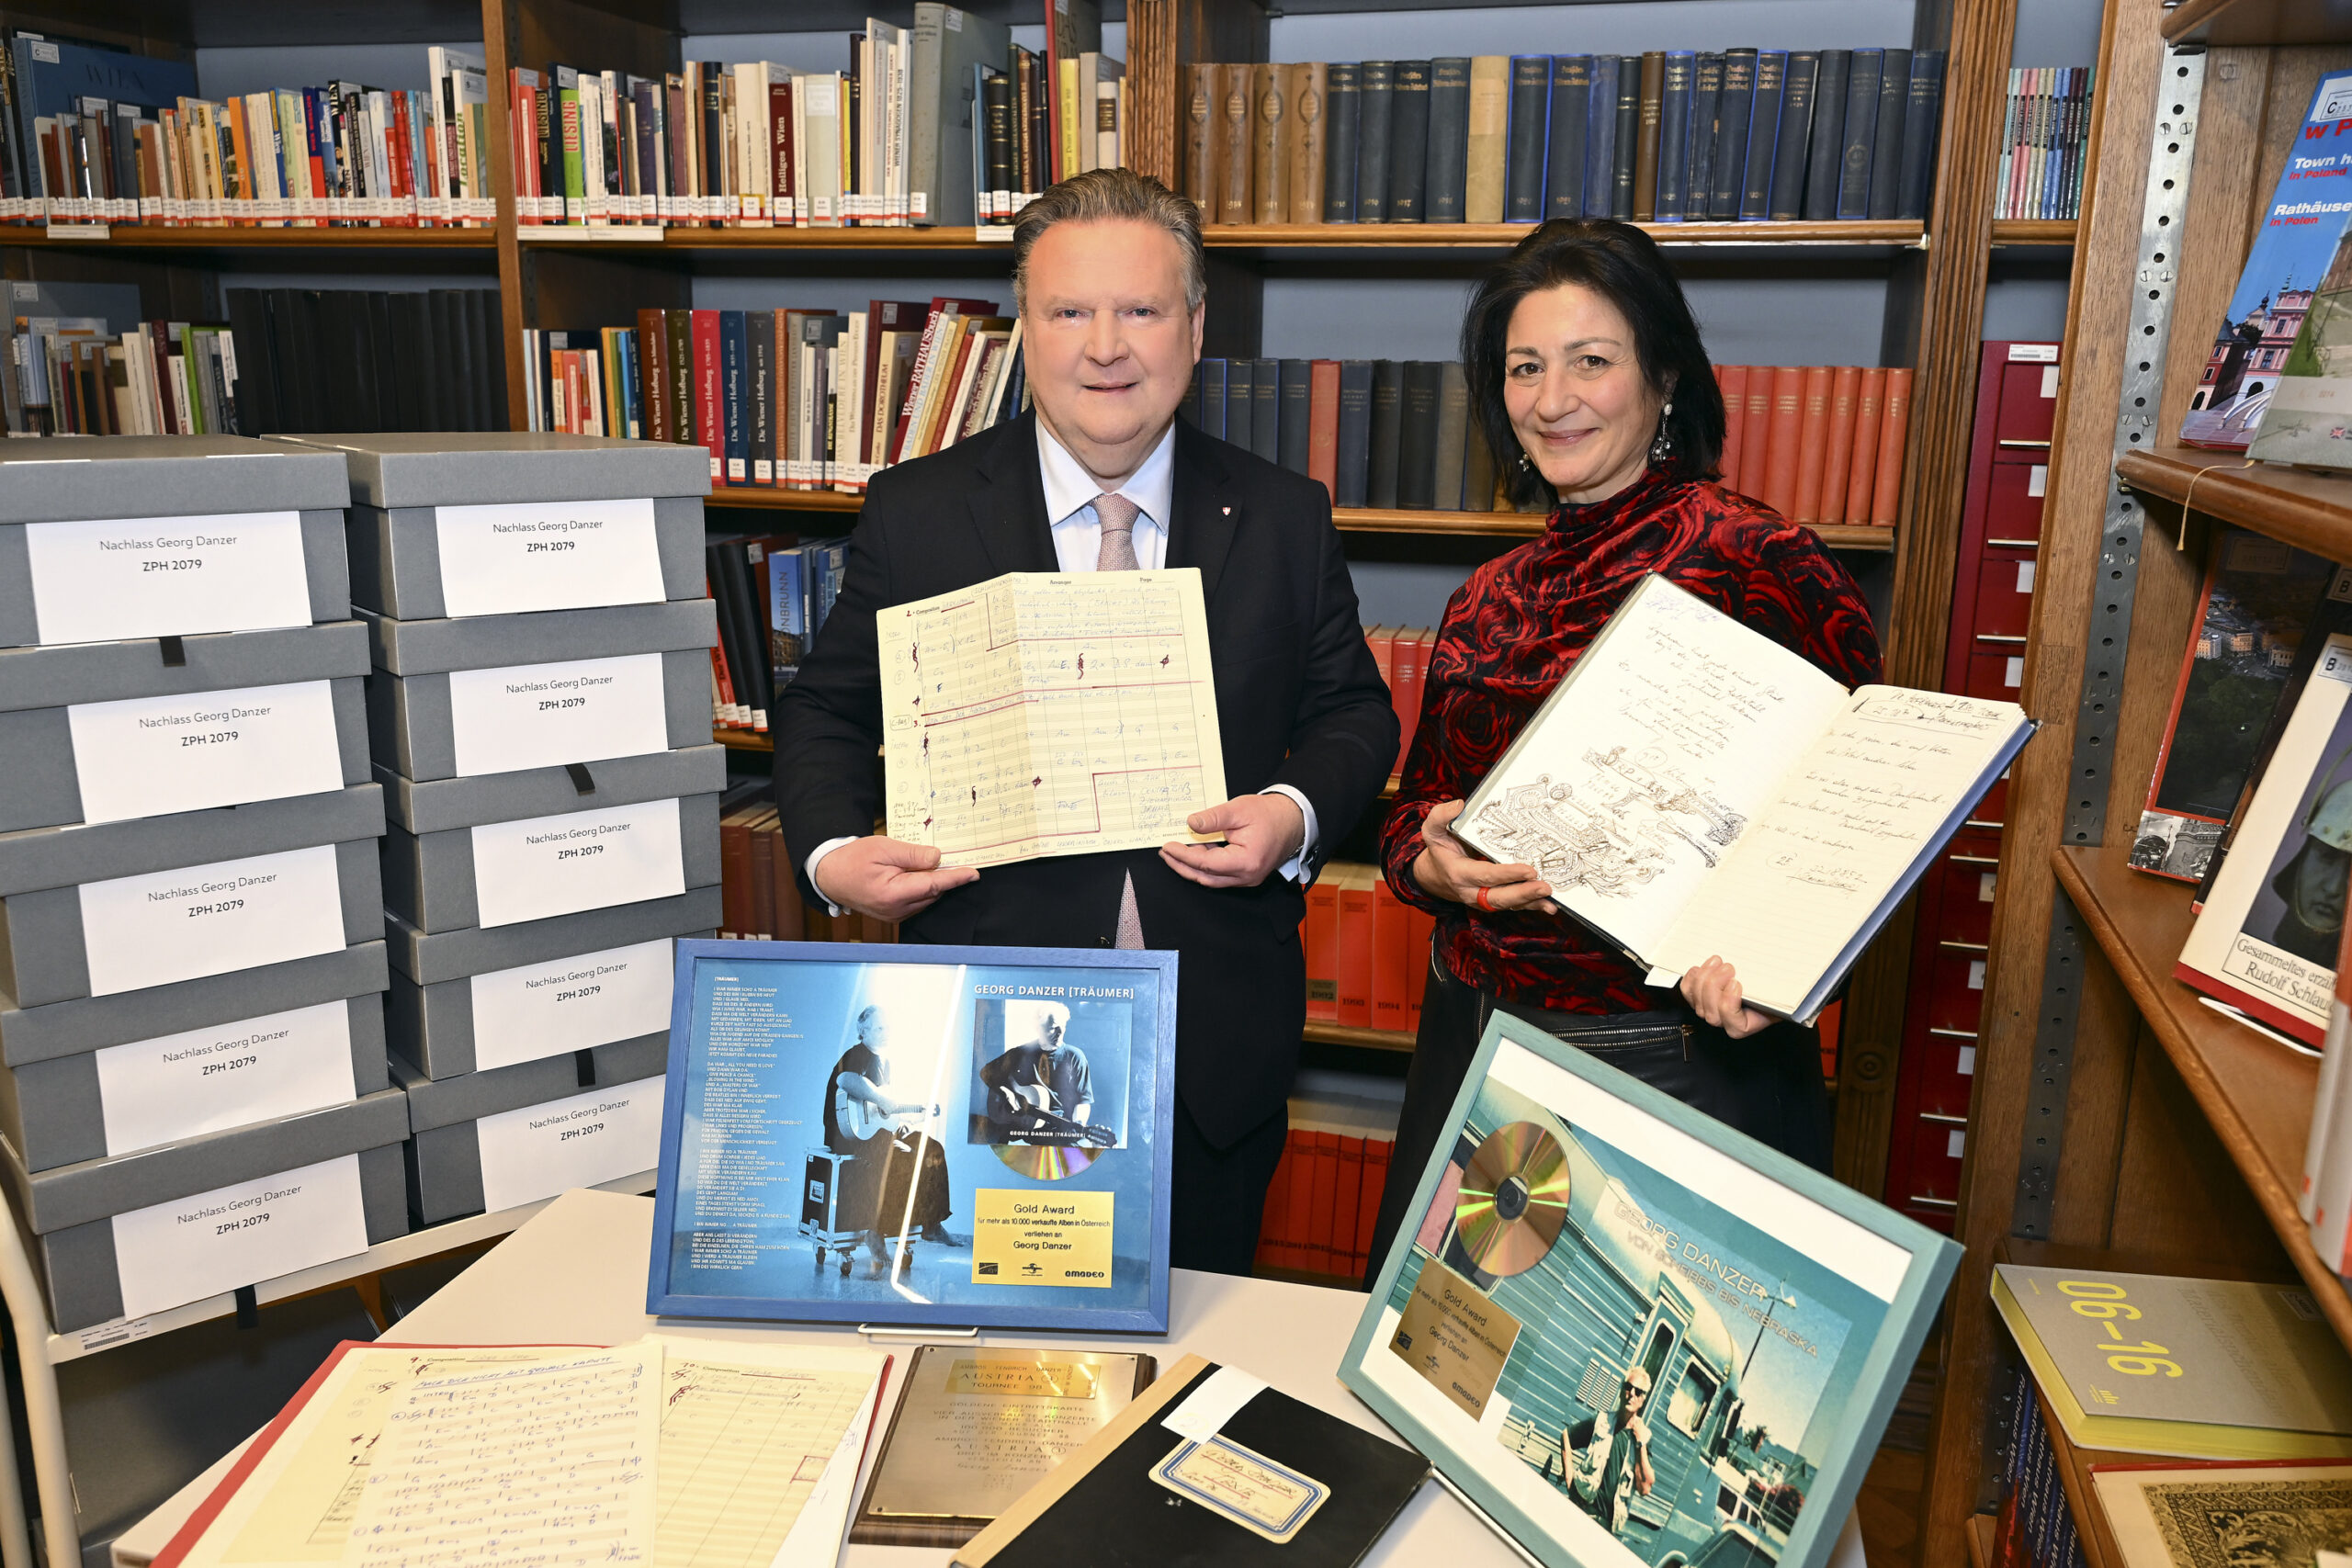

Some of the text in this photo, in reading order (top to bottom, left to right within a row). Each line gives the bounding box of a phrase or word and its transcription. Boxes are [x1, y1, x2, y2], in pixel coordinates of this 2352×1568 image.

[329, 85, 339, 116] WIEN
[537, 93, 549, 138] LIESING
[562, 101, 579, 152] LIESING
[2334, 118, 2352, 136] P
[457, 112, 468, 186] Location
[776, 117, 787, 193] Heiliges Wien
[2295, 156, 2335, 169] Town
[2289, 167, 2347, 180] in Poland
[2285, 217, 2319, 225] Polen
[901, 309, 940, 418] Wiener RATHAUSbuch
[756, 369, 765, 400] Hofburg
[878, 364, 888, 413] DOROTHEUM
[650, 367, 663, 439] Die Wiener Hofburg
[677, 368, 690, 440] Die Wiener Hofburg
[703, 369, 715, 442] Die Wiener Hofburg
[729, 369, 739, 442] Die Wiener Hofburg
[757, 401, 765, 427] Wiener
[493, 519, 603, 534] Nachlass Georg Danzer
[100, 535, 237, 551] Nachlass Georg Danzer
[526, 541, 575, 553] ZPH 2079
[142, 558, 202, 572] ZPH 2079
[506, 675, 613, 694] Nachlass Georg Danzer
[139, 705, 272, 729] Nachlass Georg Danzer
[538, 697, 585, 711] ZPH 2079
[181, 730, 239, 747] ZPH 2079
[526, 821, 631, 845] Nachlass Georg Danzer
[558, 844, 605, 860] ZPH 2079
[148, 872, 277, 902] Nachlass Georg Danzer
[187, 898, 244, 918] ZPH 2079
[2237, 939, 2306, 977] Gesammeltes
[526, 962, 628, 990] Nachlass Georg Danzer
[2245, 961, 2333, 1010] Rudolf Schlau
[557, 986, 601, 1002] ZPH 2079
[974, 985, 1134, 999] GEORG DANZER [TRÄUMER]
[163, 1029, 289, 1064] Nachlass Georg Danzer
[201, 1055, 257, 1077] ZPH 2079
[529, 1099, 630, 1131] Nachlass Georg Danzer
[560, 1122, 605, 1142] ZPH 2079
[177, 1184, 302, 1225] Nachlass Georg Danzer
[1014, 1204, 1075, 1214] Gold Award
[216, 1213, 270, 1235] ZPH 2079
[1080, 1219, 1110, 1227] Österreich
[1013, 1241, 1072, 1250] Georg Danzer
[1613, 1201, 1767, 1303] GEORG DANZER
[1443, 1289, 1487, 1326] Gold Award
[1627, 1232, 1818, 1358] VON SCHEIBBS BIS NEBRASKA
[1429, 1325, 1470, 1362] Georg Danzer
[2007, 1373, 2026, 1483] Rathaus Wien
